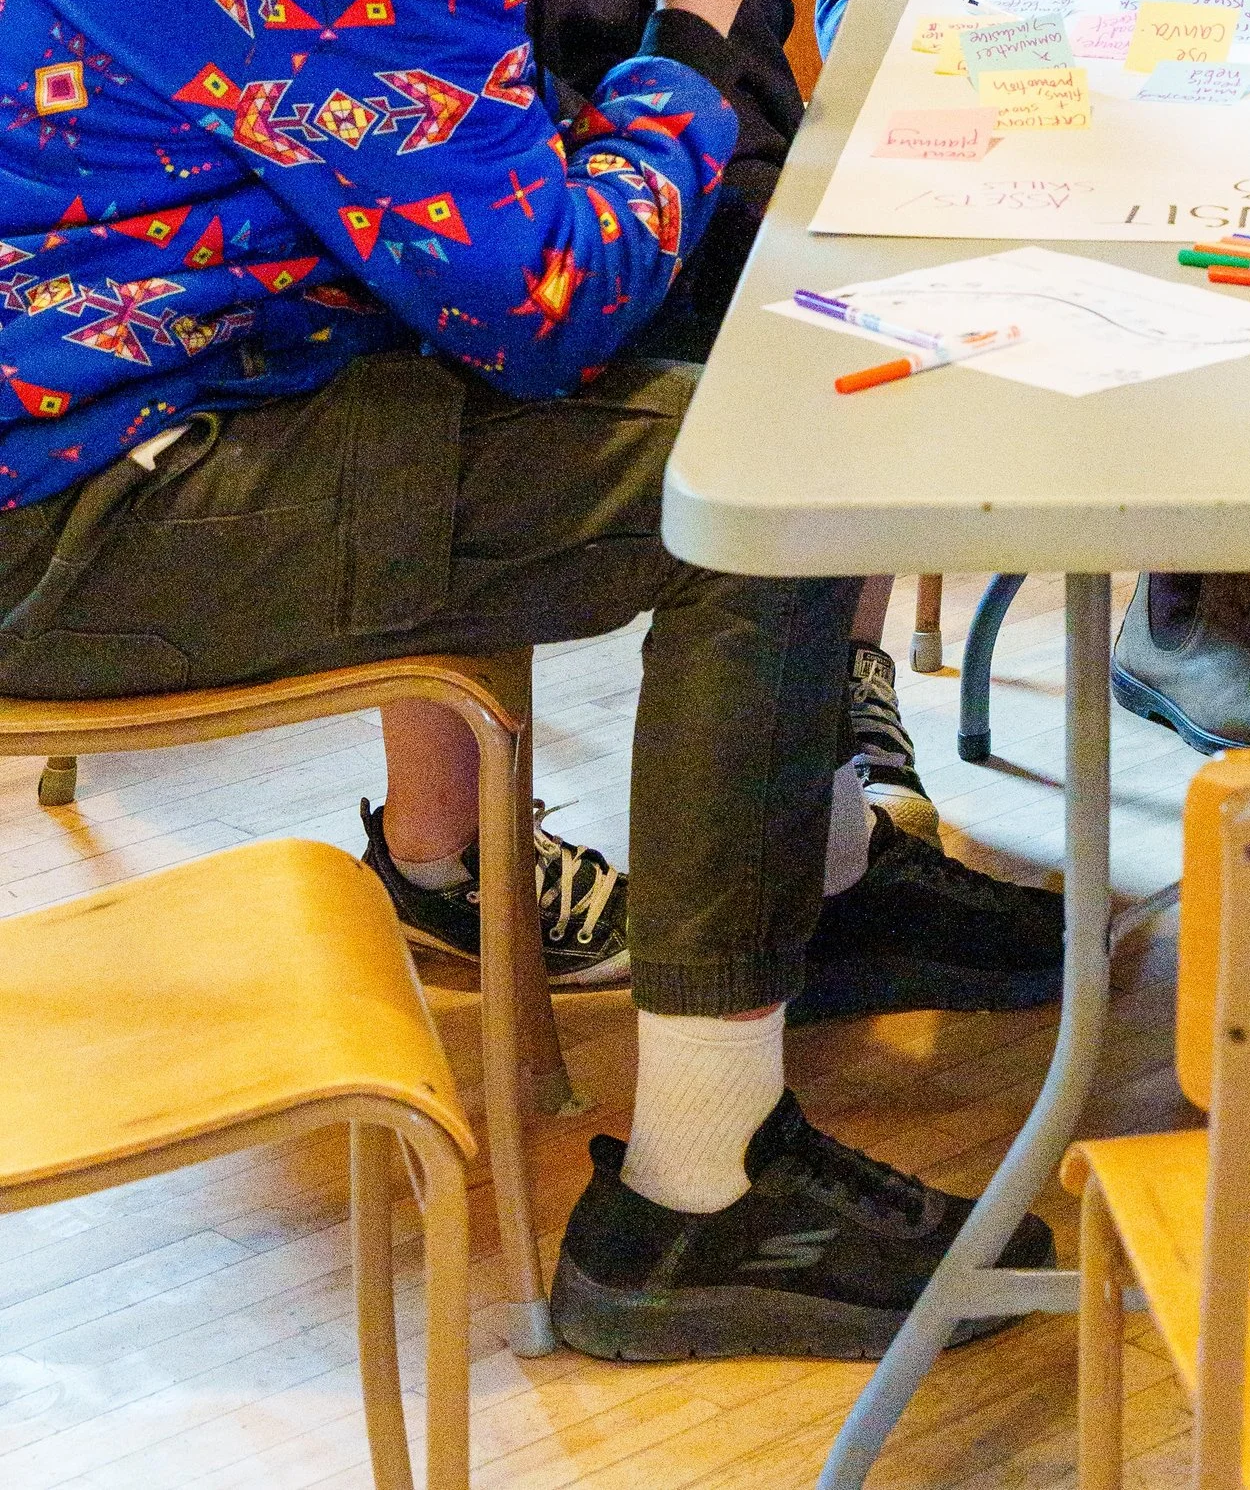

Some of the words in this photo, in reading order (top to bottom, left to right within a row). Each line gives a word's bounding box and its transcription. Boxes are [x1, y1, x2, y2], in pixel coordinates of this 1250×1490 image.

[968, 22, 1030, 44] inclusive
[974, 31, 1063, 62] communities
[992, 71, 1074, 96] promotion
[886, 128, 979, 155] planning
